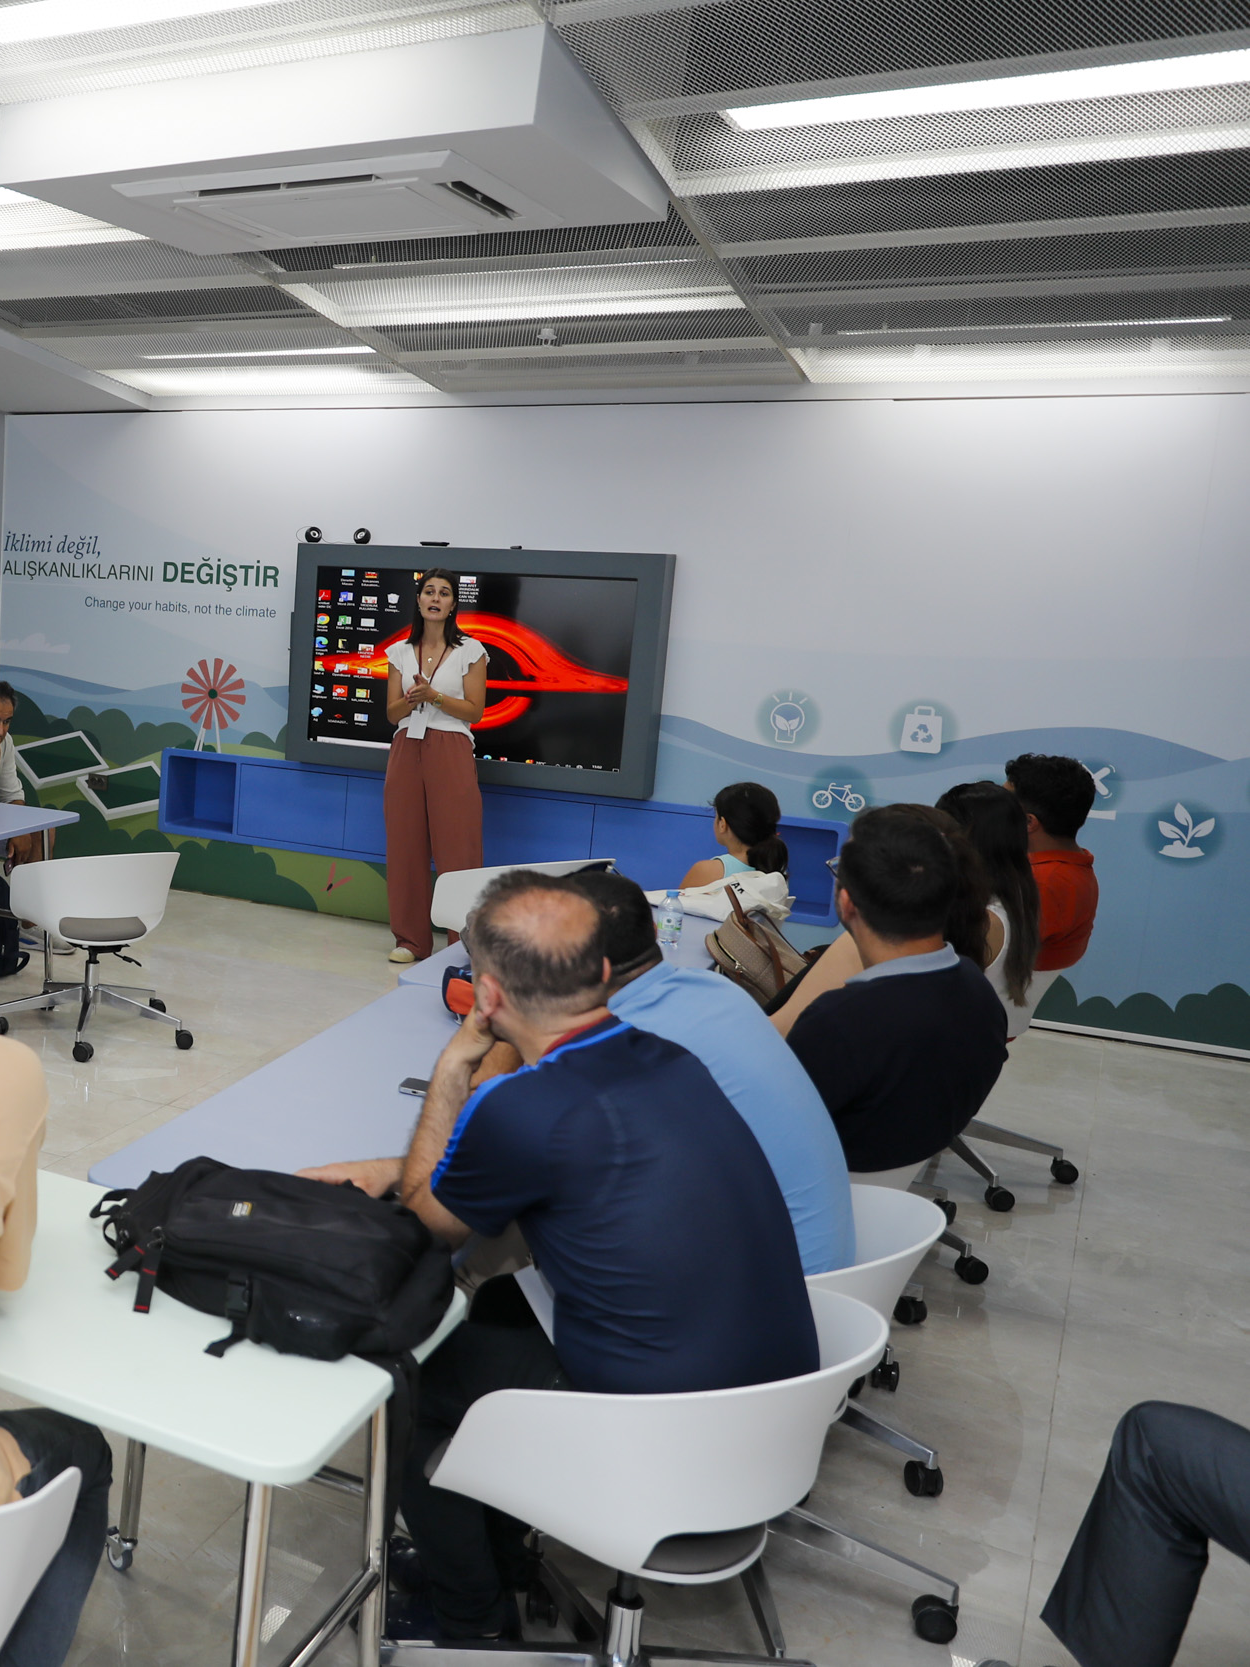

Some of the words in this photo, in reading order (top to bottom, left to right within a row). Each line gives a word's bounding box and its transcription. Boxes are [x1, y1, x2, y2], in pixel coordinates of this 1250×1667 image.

[3, 531, 53, 553] İklimi
[56, 534, 101, 560] değil,
[3, 559, 154, 582] ALIŞKANLIKLARINI
[162, 556, 280, 592] DEĞİŞTİR
[84, 596, 125, 611] Change
[128, 601, 152, 612] your
[155, 600, 191, 615] habits,
[194, 603, 212, 615] not
[215, 604, 233, 616] the
[235, 605, 277, 619] climate
